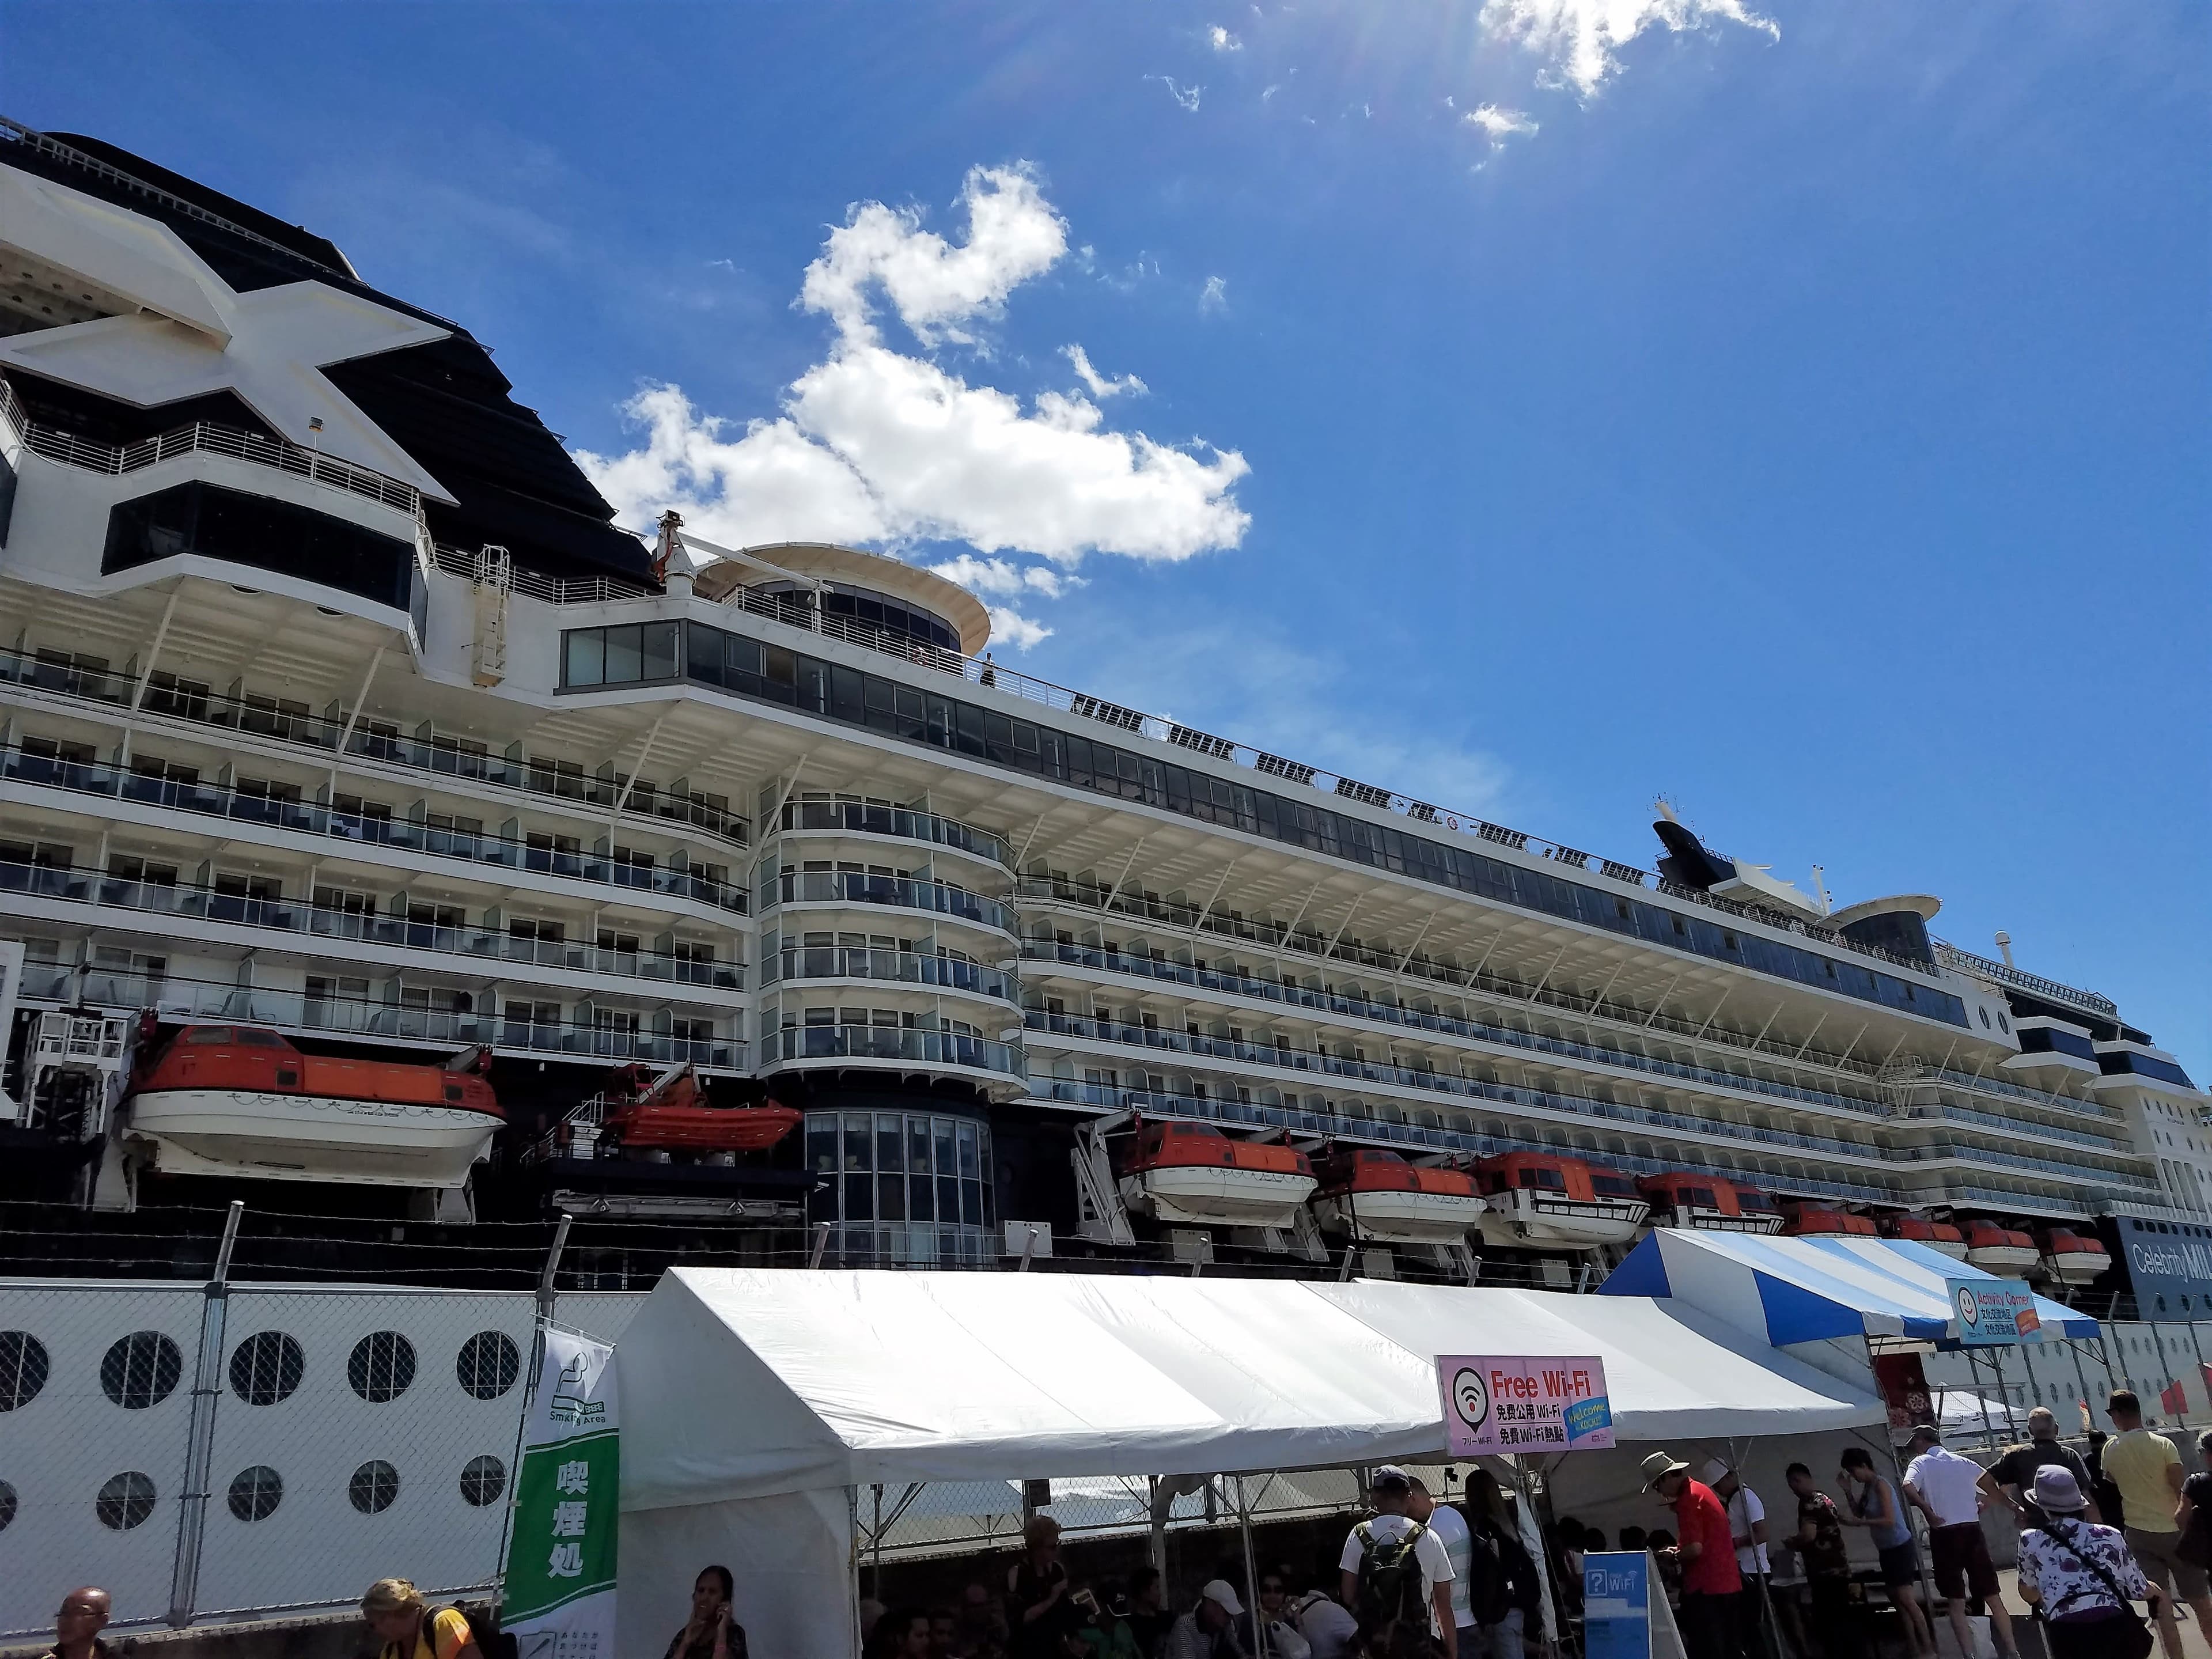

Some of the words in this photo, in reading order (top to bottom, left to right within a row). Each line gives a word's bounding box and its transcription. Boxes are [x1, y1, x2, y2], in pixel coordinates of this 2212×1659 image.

[2133, 1243, 2188, 1283] Celebrity
[1977, 1290, 2004, 1306] Activity
[2006, 1291, 2029, 1306] Corner
[1491, 1370, 1538, 1398] Free
[1542, 1370, 1592, 1397] Wi-Fi
[584, 1416, 606, 1425] Area
[1497, 1403, 1535, 1421] 免费公用
[1536, 1403, 1561, 1418] Wi-Fi
[548, 1460, 589, 1580] 喫煙処
